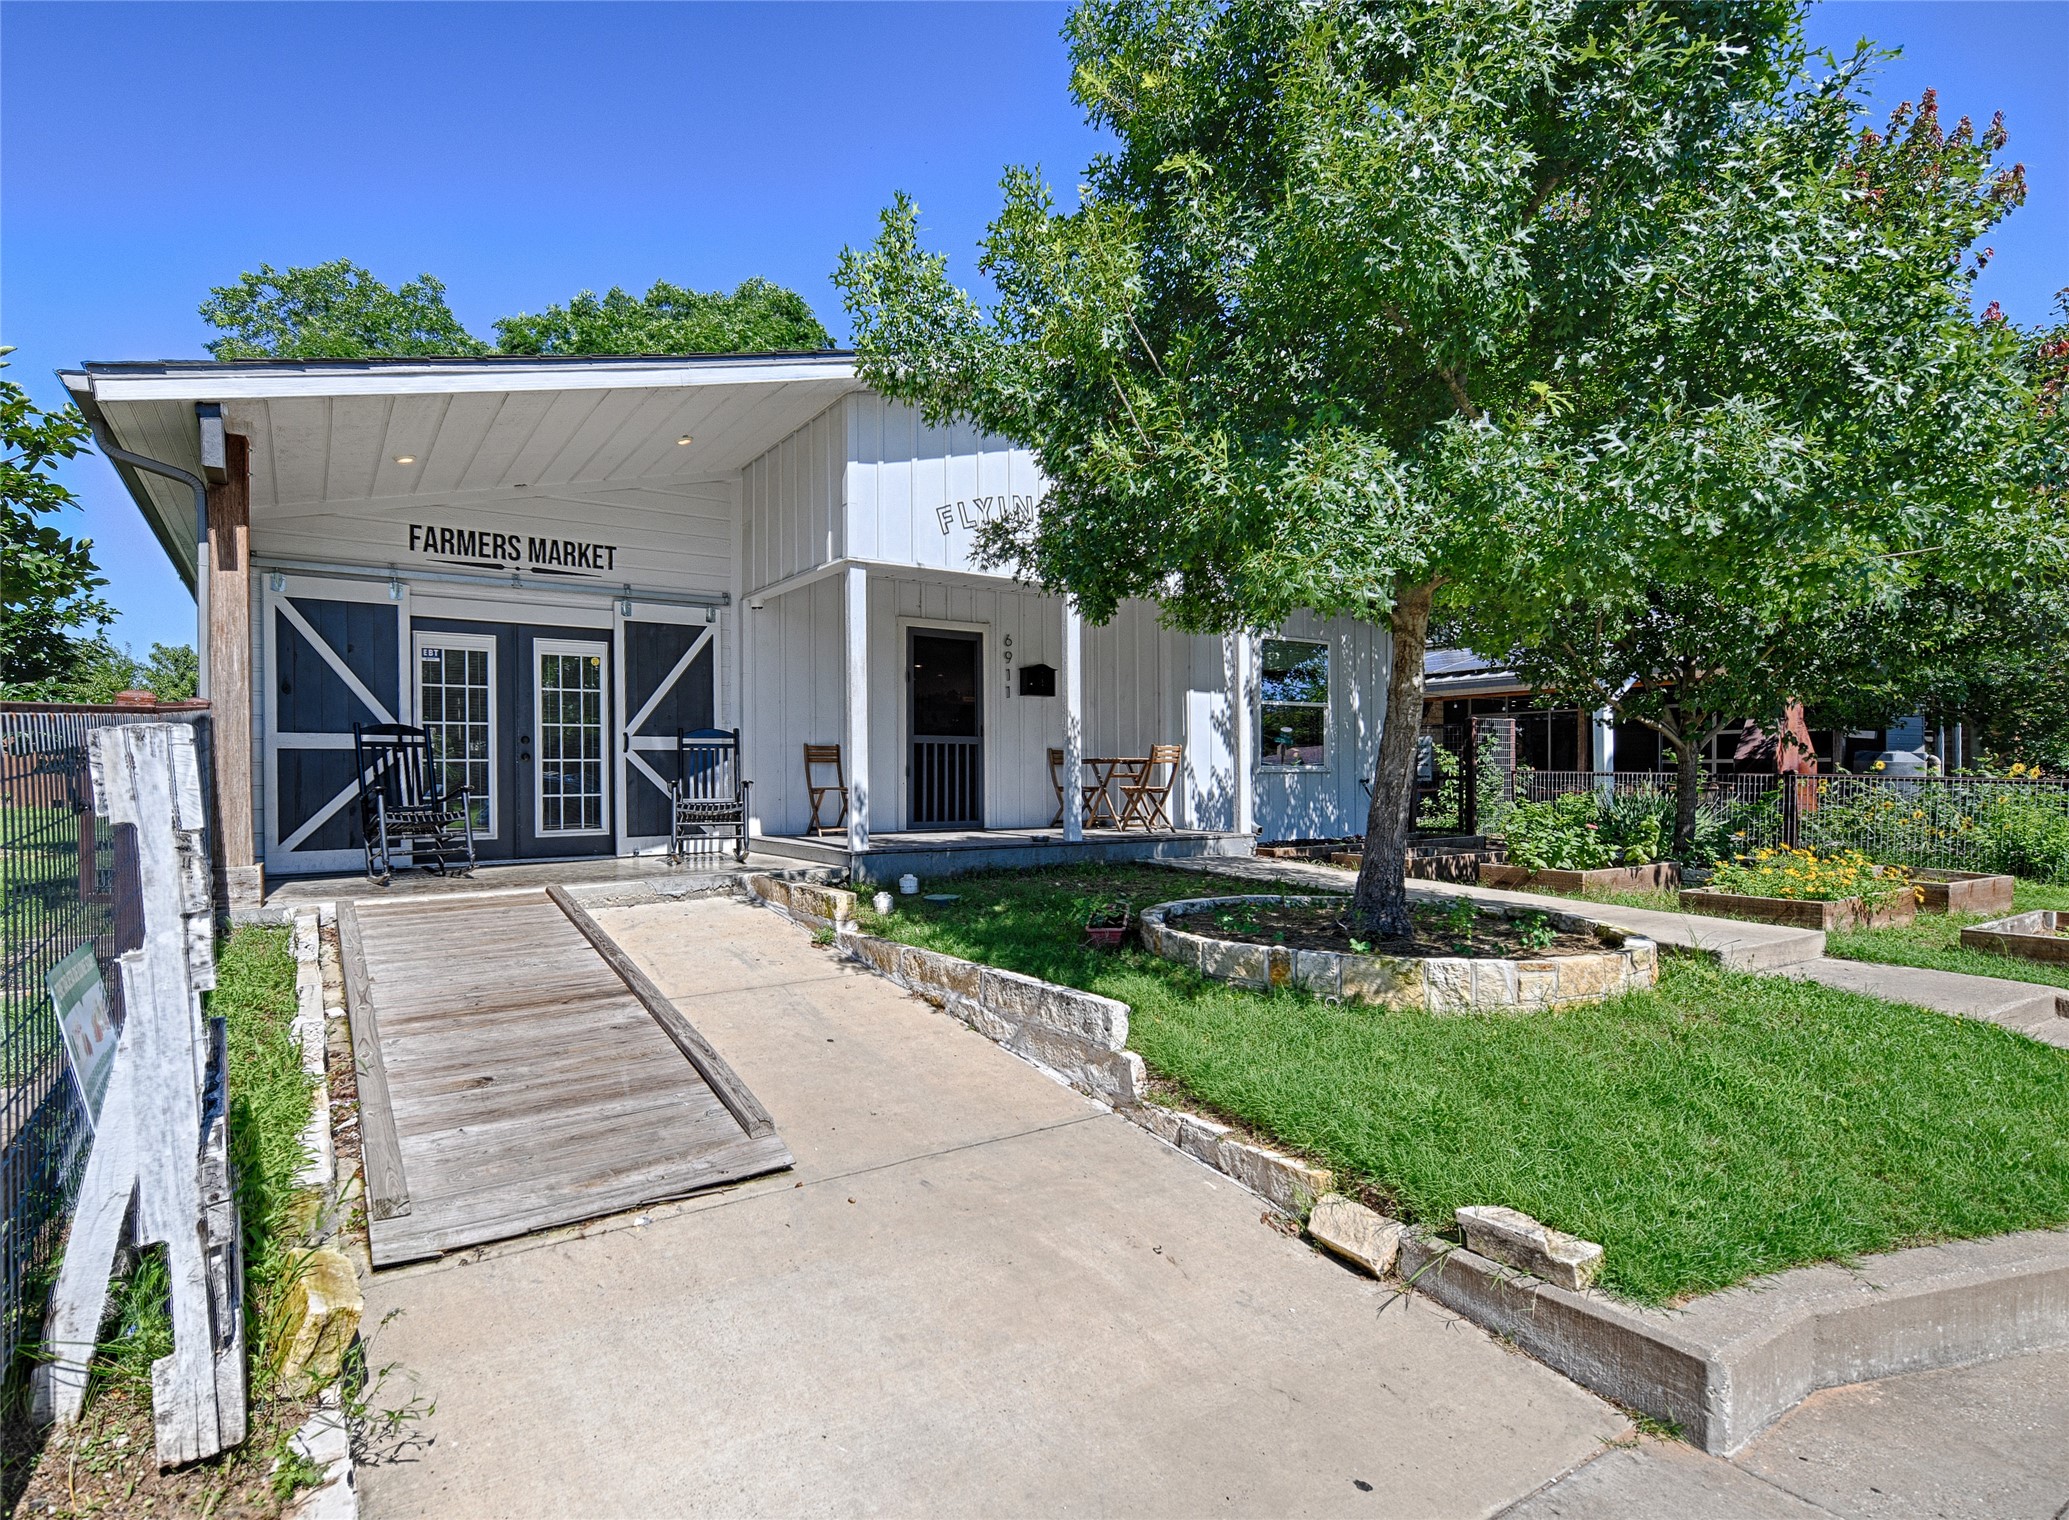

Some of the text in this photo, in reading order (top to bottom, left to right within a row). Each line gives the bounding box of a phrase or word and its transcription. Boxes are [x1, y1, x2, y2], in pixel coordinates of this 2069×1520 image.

[936, 495, 1034, 535] FLYIN
[408, 524, 617, 571] FARMERS MARKET
[423, 649, 439, 657] EBT
[1004, 633, 1013, 698] 6911
